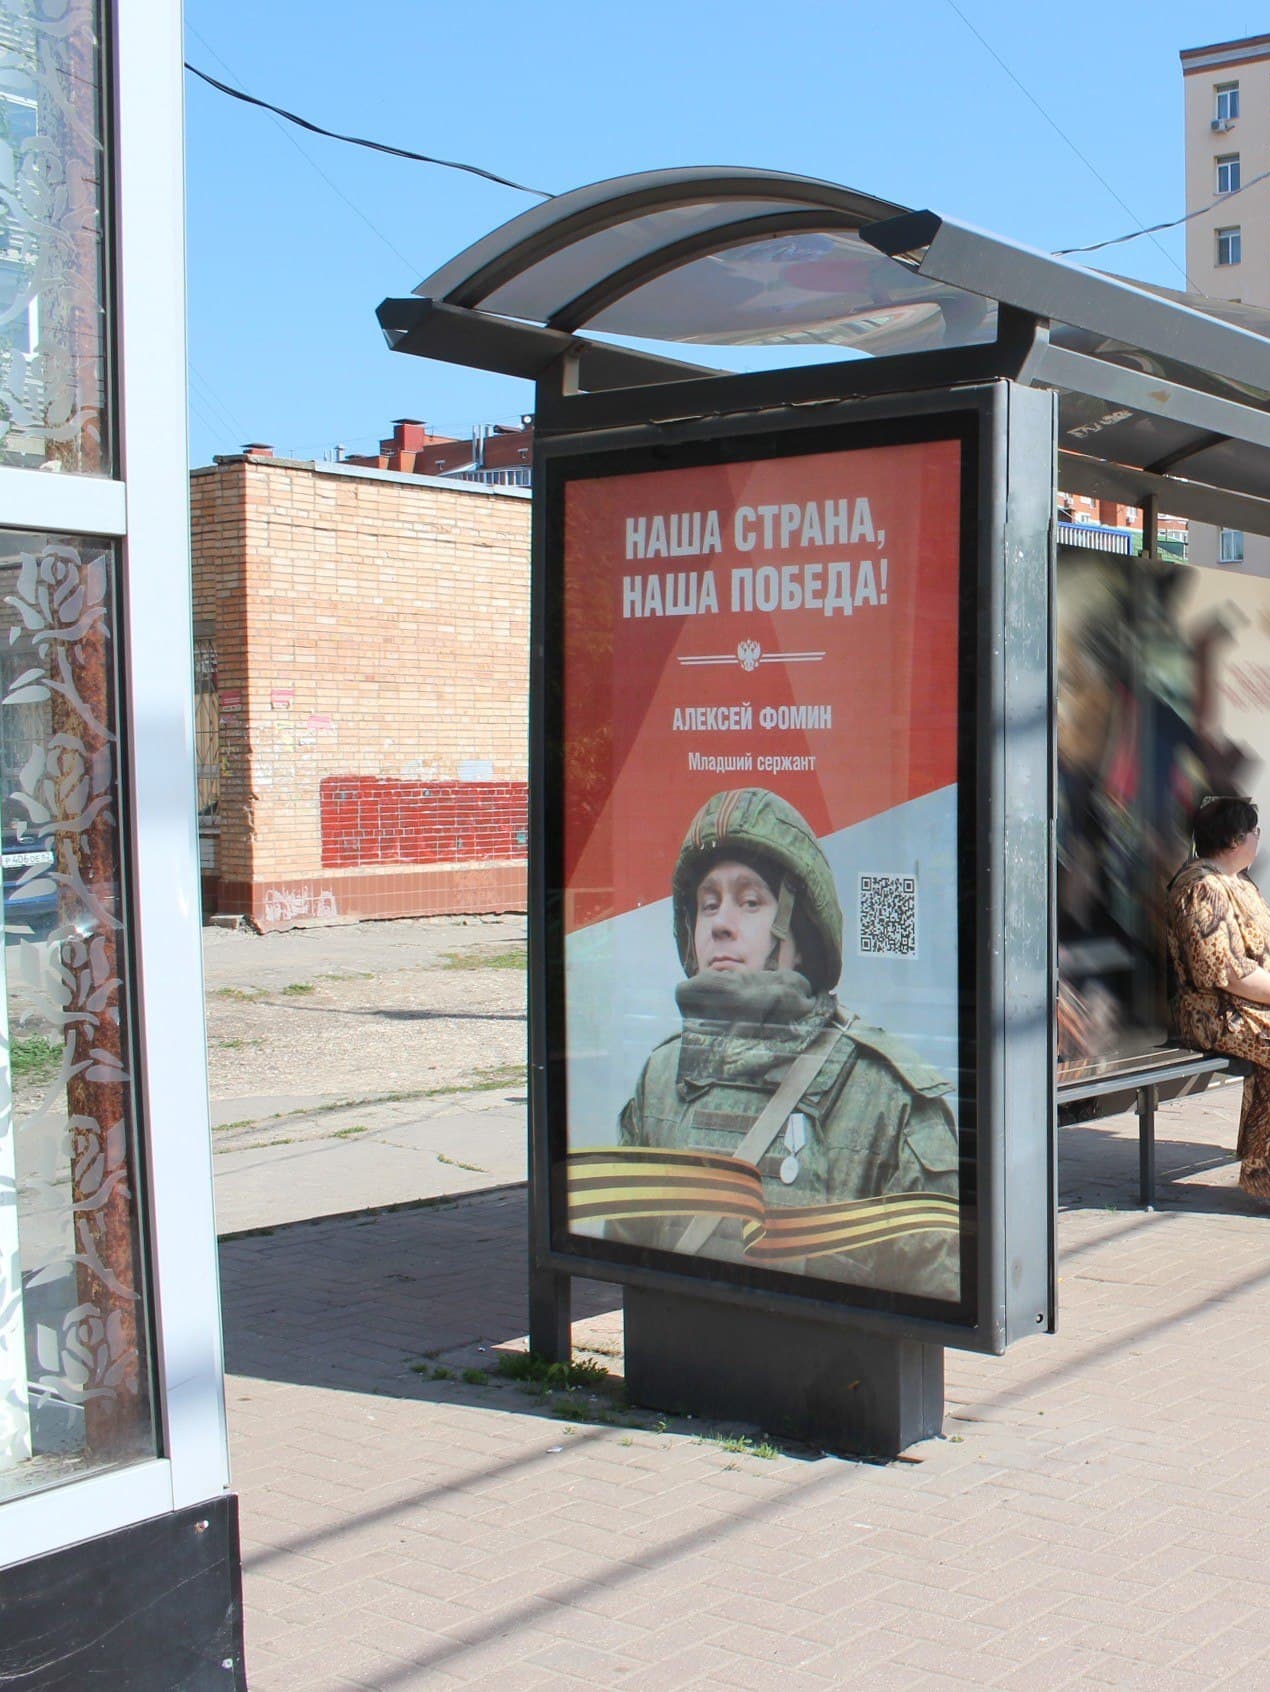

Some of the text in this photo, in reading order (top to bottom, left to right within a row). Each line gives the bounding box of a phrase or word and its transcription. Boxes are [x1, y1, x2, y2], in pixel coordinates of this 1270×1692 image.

[625, 497, 886, 560] НАША СТРАНА,
[623, 558, 889, 619] НАША ПОБЕДА!
[672, 702, 832, 731] АЛЕКСЕЙ ФОМИН
[688, 751, 816, 775] Младший сержант
